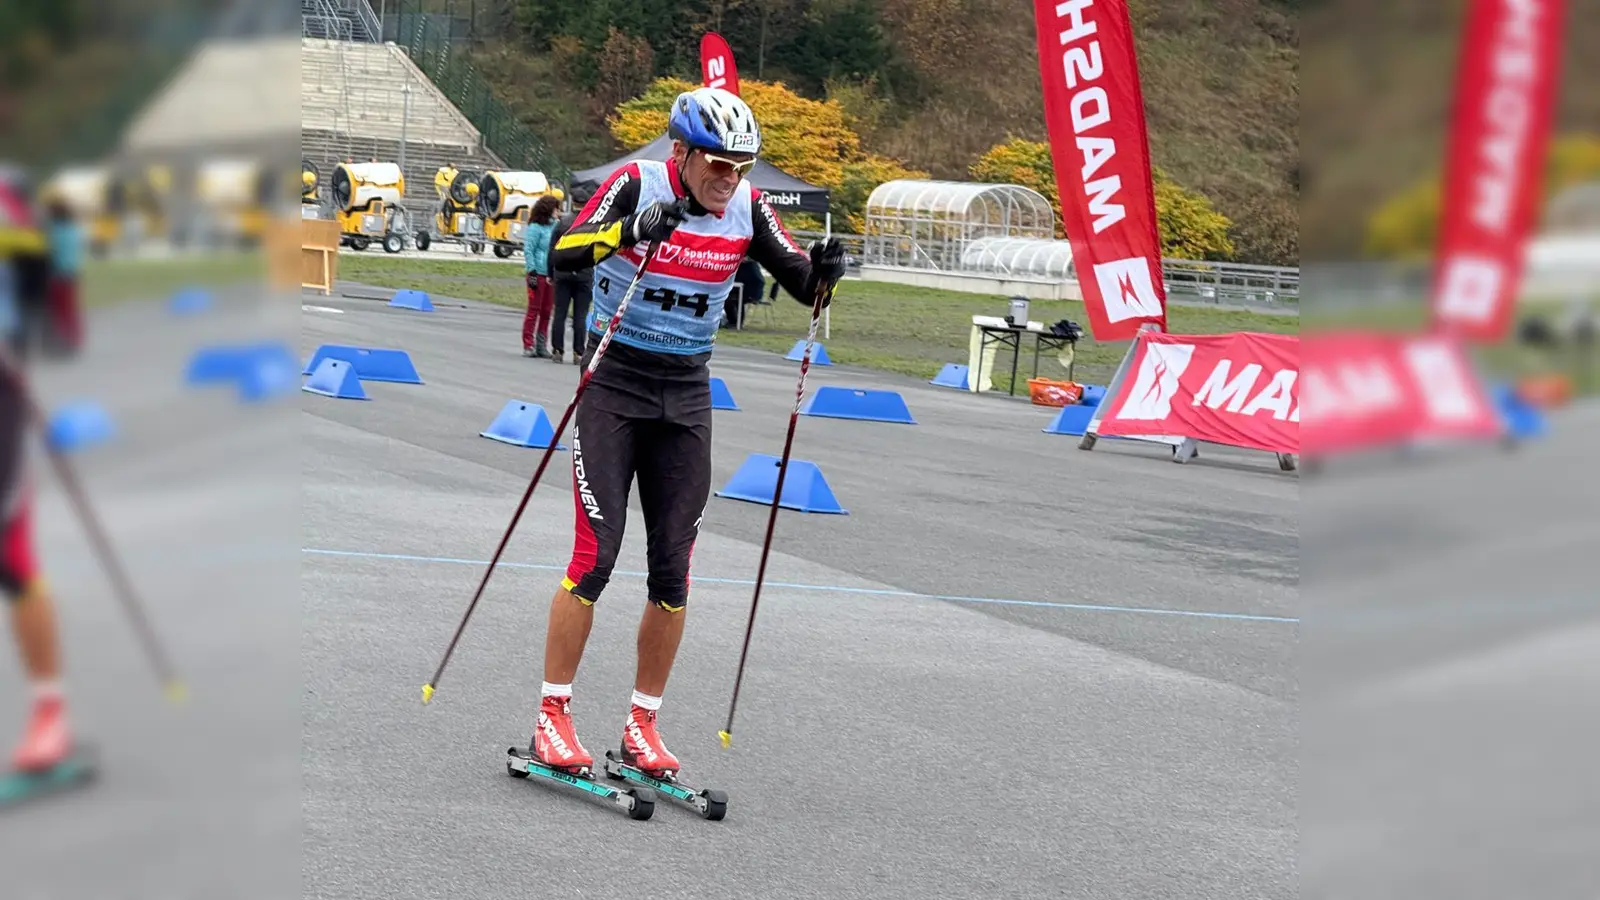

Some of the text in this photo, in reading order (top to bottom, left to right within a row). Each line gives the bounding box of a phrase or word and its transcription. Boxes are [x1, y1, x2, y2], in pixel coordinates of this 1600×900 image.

[598, 276, 610, 295] 4
[643, 287, 709, 317] 44
[1192, 359, 1300, 422] MA
